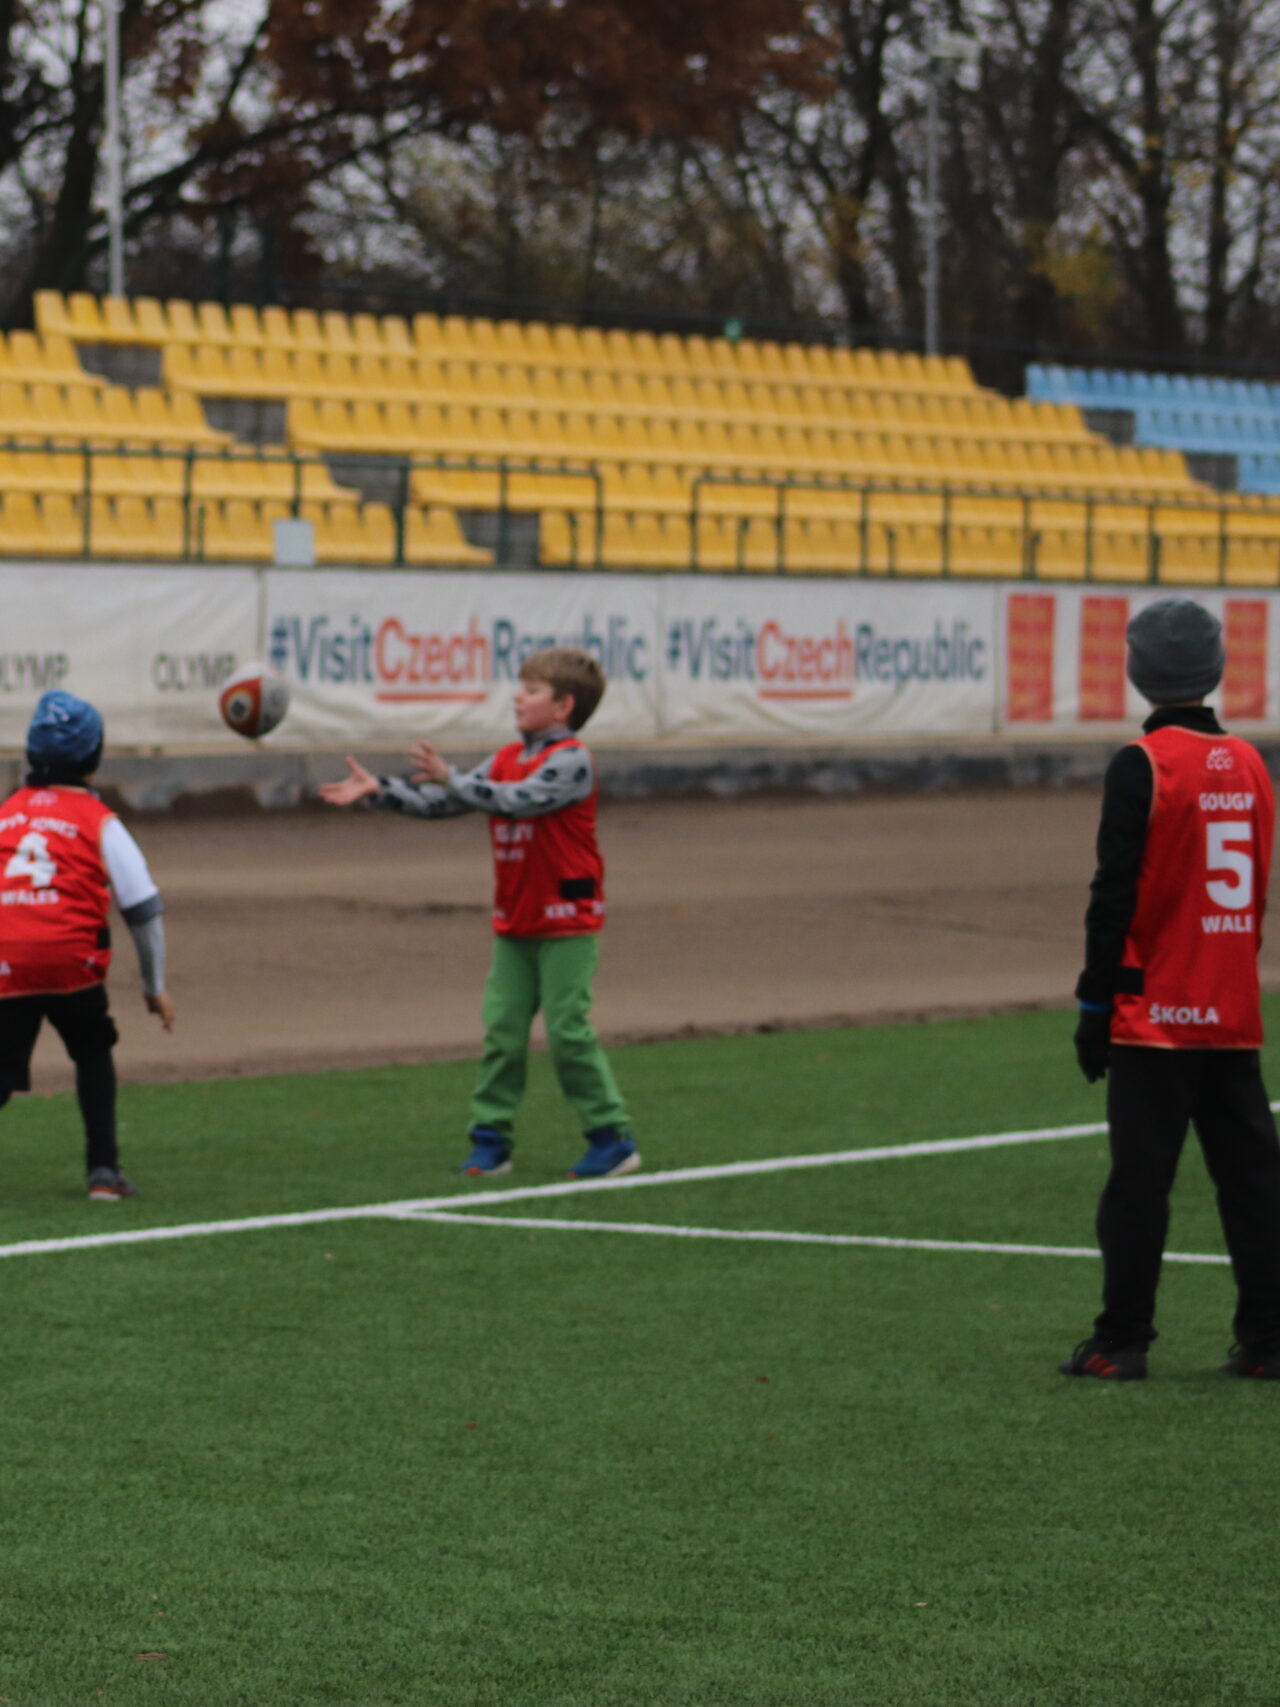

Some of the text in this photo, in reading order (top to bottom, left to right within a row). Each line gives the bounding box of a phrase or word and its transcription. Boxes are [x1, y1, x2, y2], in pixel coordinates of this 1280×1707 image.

[270, 615, 648, 686] #VisitCzechReblic
[667, 616, 987, 689] #VisitCzechRepublic
[3, 831, 58, 888] 4
[1205, 820, 1254, 911] 5
[1148, 1002, 1220, 1024] ŠKOLA
